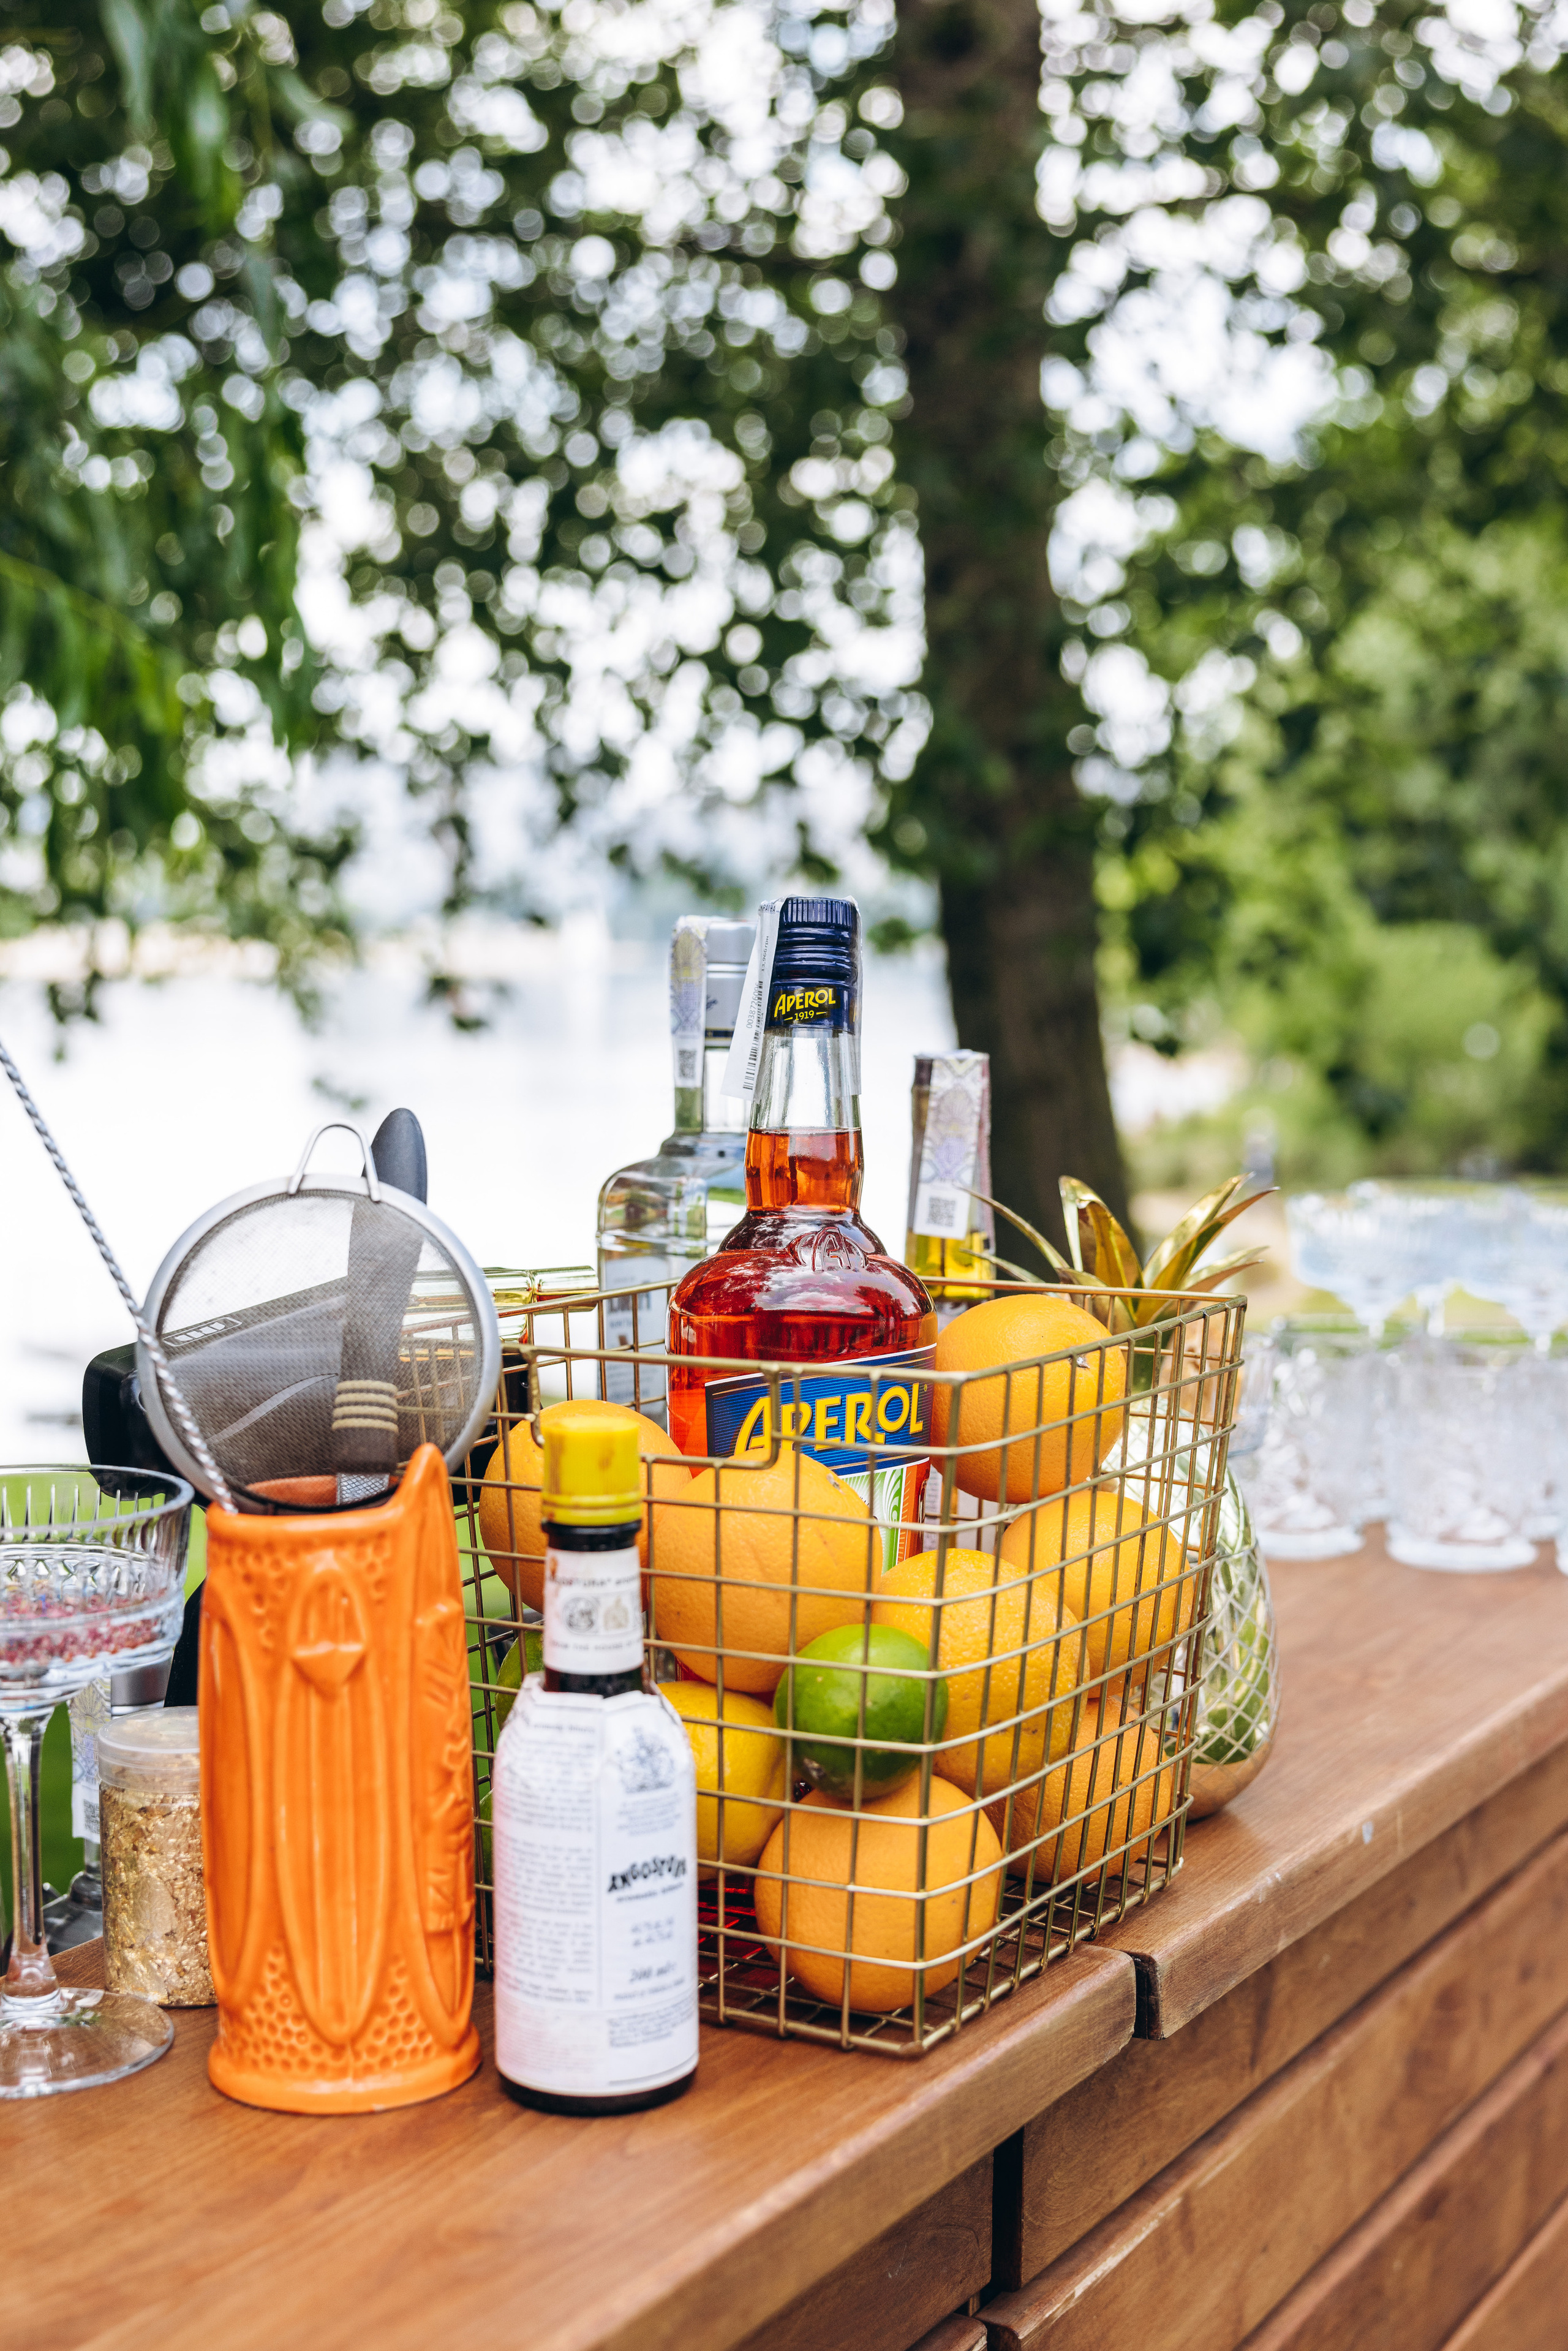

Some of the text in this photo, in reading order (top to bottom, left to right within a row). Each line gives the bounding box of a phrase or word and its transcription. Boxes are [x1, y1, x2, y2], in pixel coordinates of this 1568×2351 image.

[774, 988, 836, 1018] APEROL
[794, 1010, 815, 1021] 1919
[734, 1382, 924, 1457] APEROL
